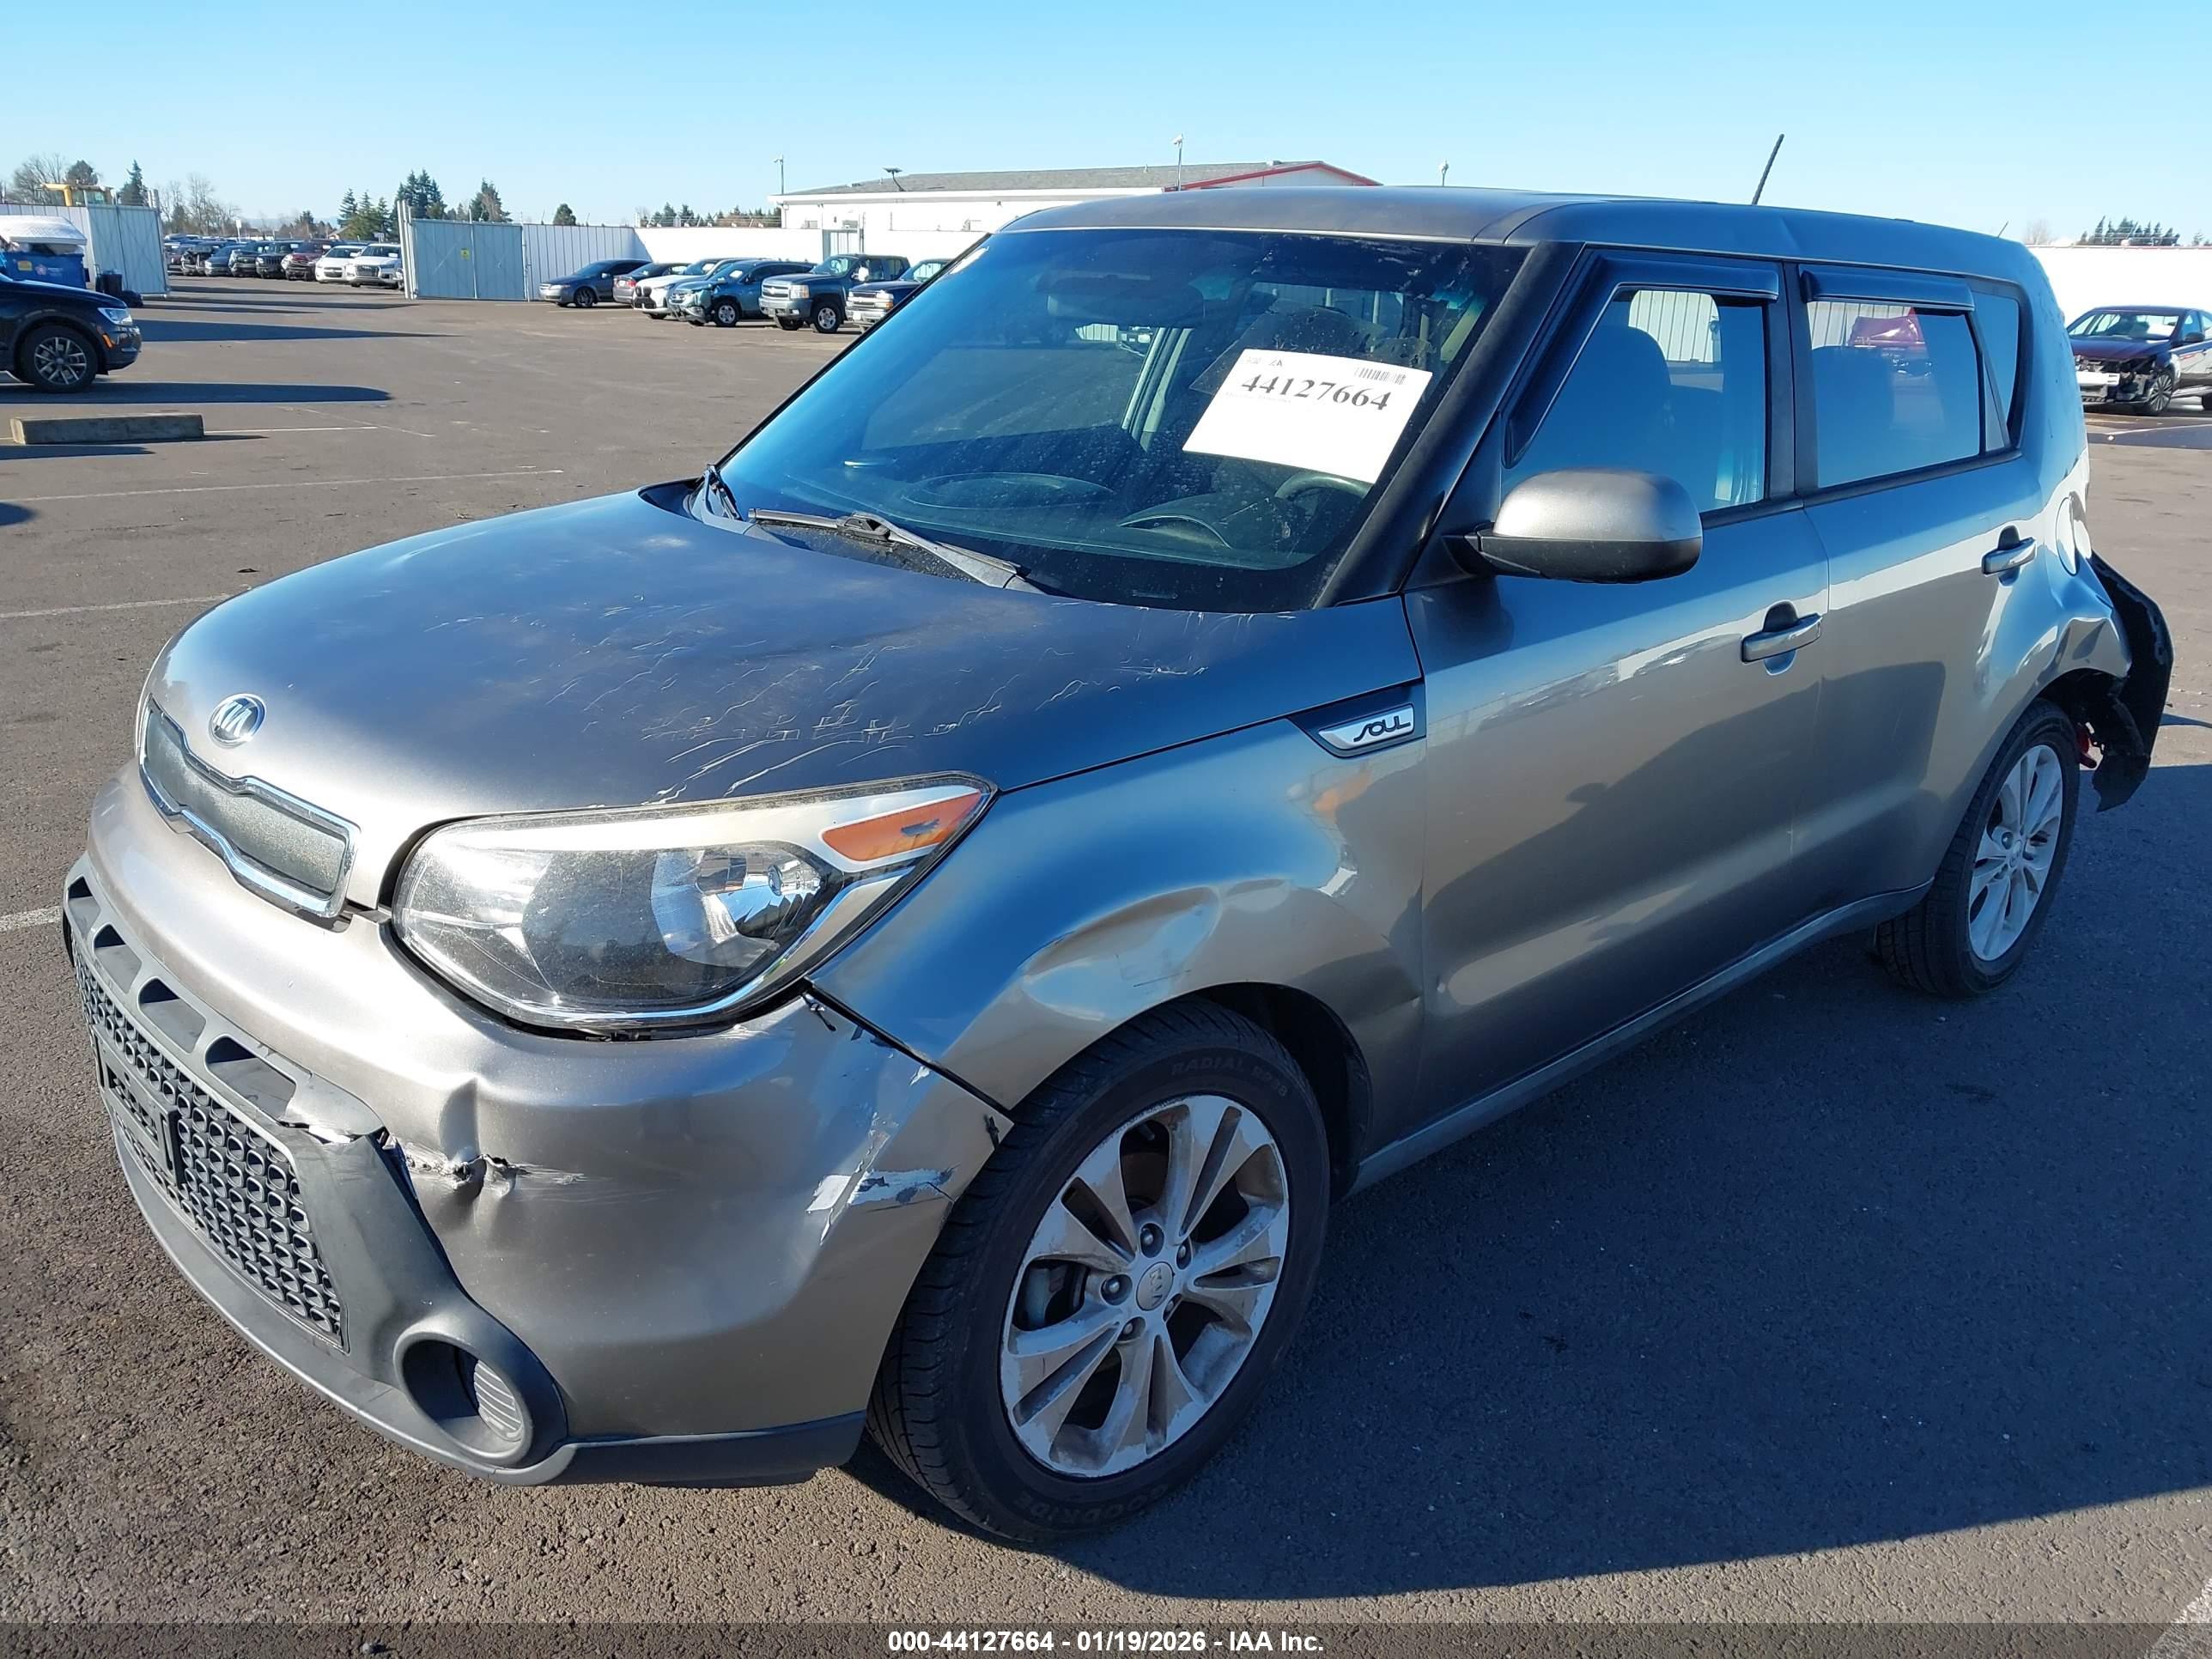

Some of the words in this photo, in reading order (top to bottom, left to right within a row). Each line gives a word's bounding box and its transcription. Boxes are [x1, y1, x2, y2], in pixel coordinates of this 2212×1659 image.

[1242, 374, 1392, 411] 44127664
[1352, 715, 1411, 743] SOUL
[1171, 1057, 1244, 1076] RADIAL
